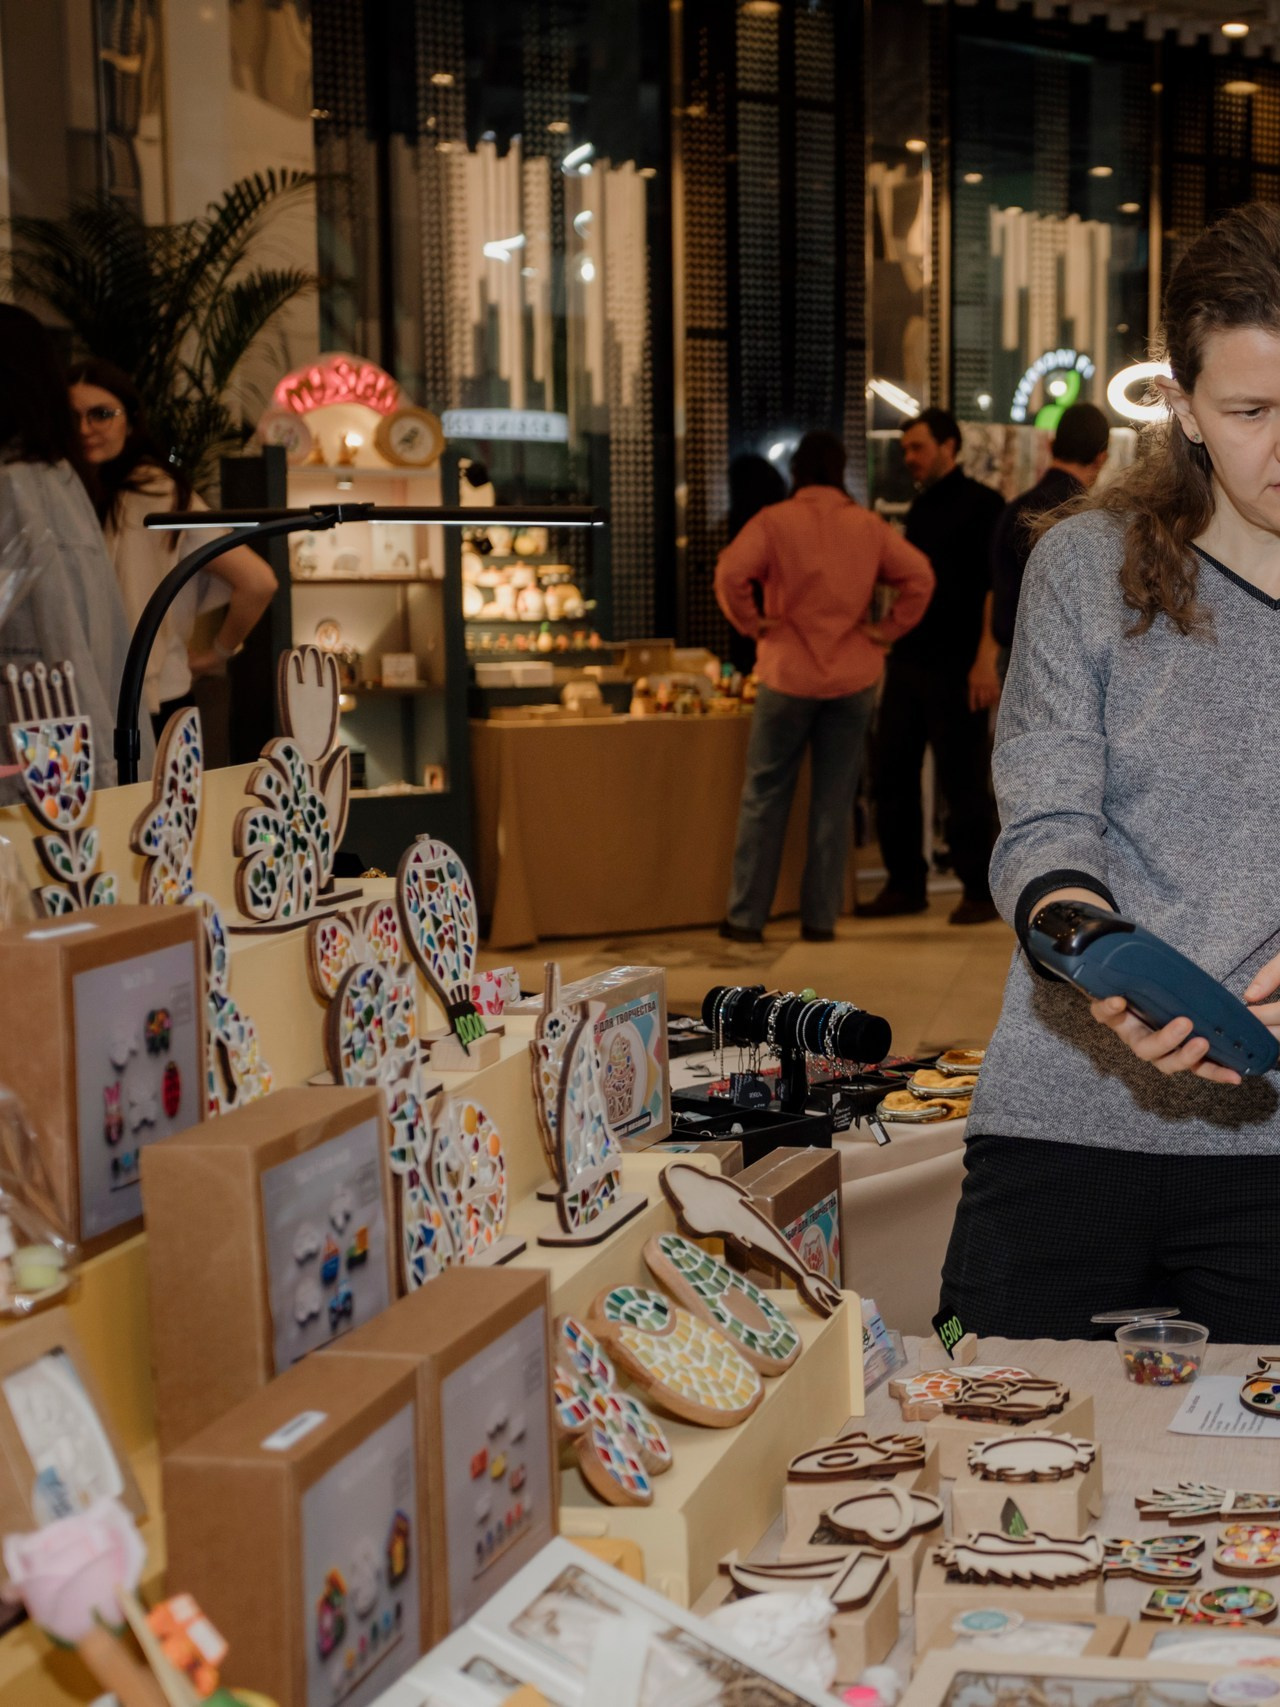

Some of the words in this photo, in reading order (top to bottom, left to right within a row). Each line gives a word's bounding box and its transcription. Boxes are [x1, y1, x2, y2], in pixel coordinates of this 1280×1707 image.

[599, 1018, 614, 1034] ДЛЯ
[616, 1000, 657, 1027] ТВОРЧЕСТВА
[939, 1315, 963, 1350] 1500
